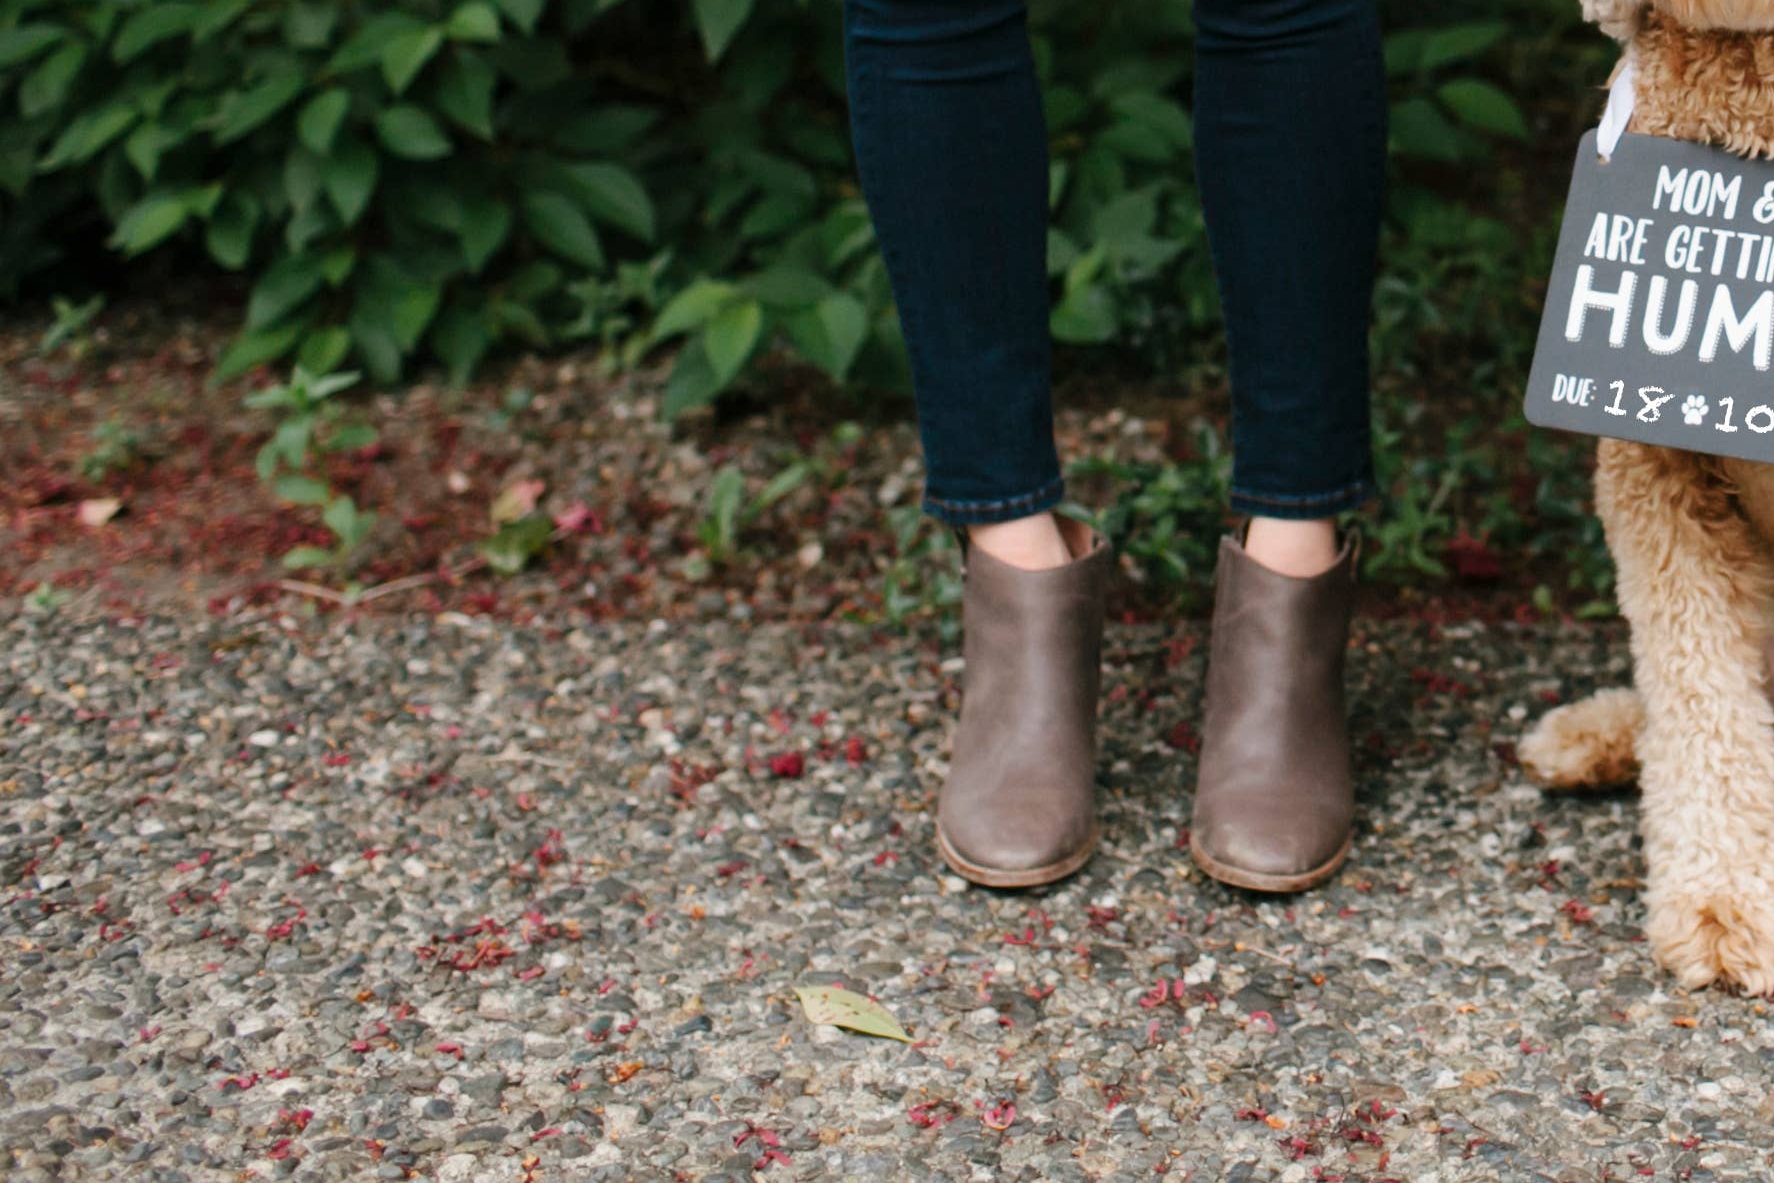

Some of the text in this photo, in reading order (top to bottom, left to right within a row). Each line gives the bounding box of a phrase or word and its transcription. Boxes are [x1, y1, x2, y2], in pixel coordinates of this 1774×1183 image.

[1652, 165, 1742, 220] MOM
[1584, 212, 1654, 265] ARE
[1552, 374, 1596, 408] DUE:
[1604, 379, 1675, 423] 18
